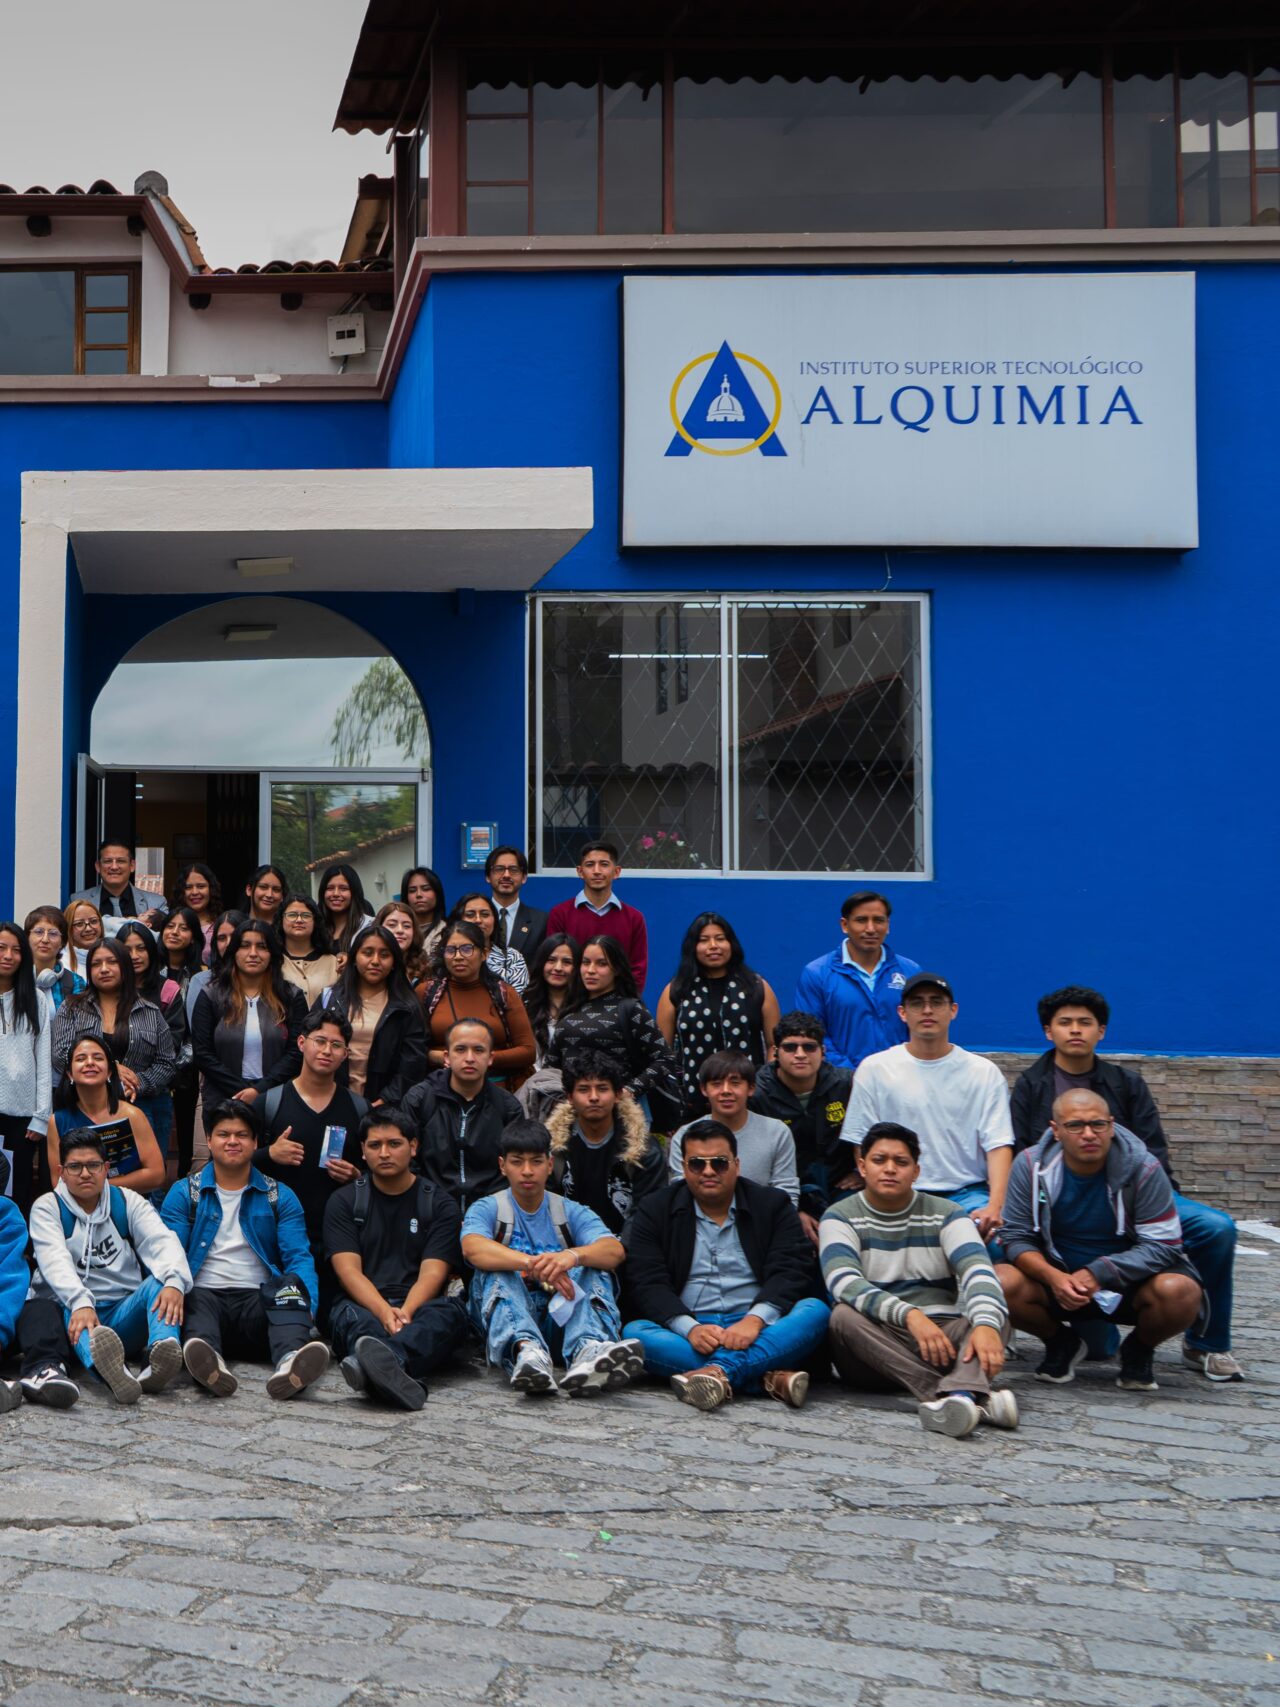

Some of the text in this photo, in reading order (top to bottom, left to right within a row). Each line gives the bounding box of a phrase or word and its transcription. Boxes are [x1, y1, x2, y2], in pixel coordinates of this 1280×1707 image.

[799, 355, 1144, 375] INSTITUTO SUPERIOR TECNOLÓGICO
[800, 385, 1144, 433] ALQUIMIA
